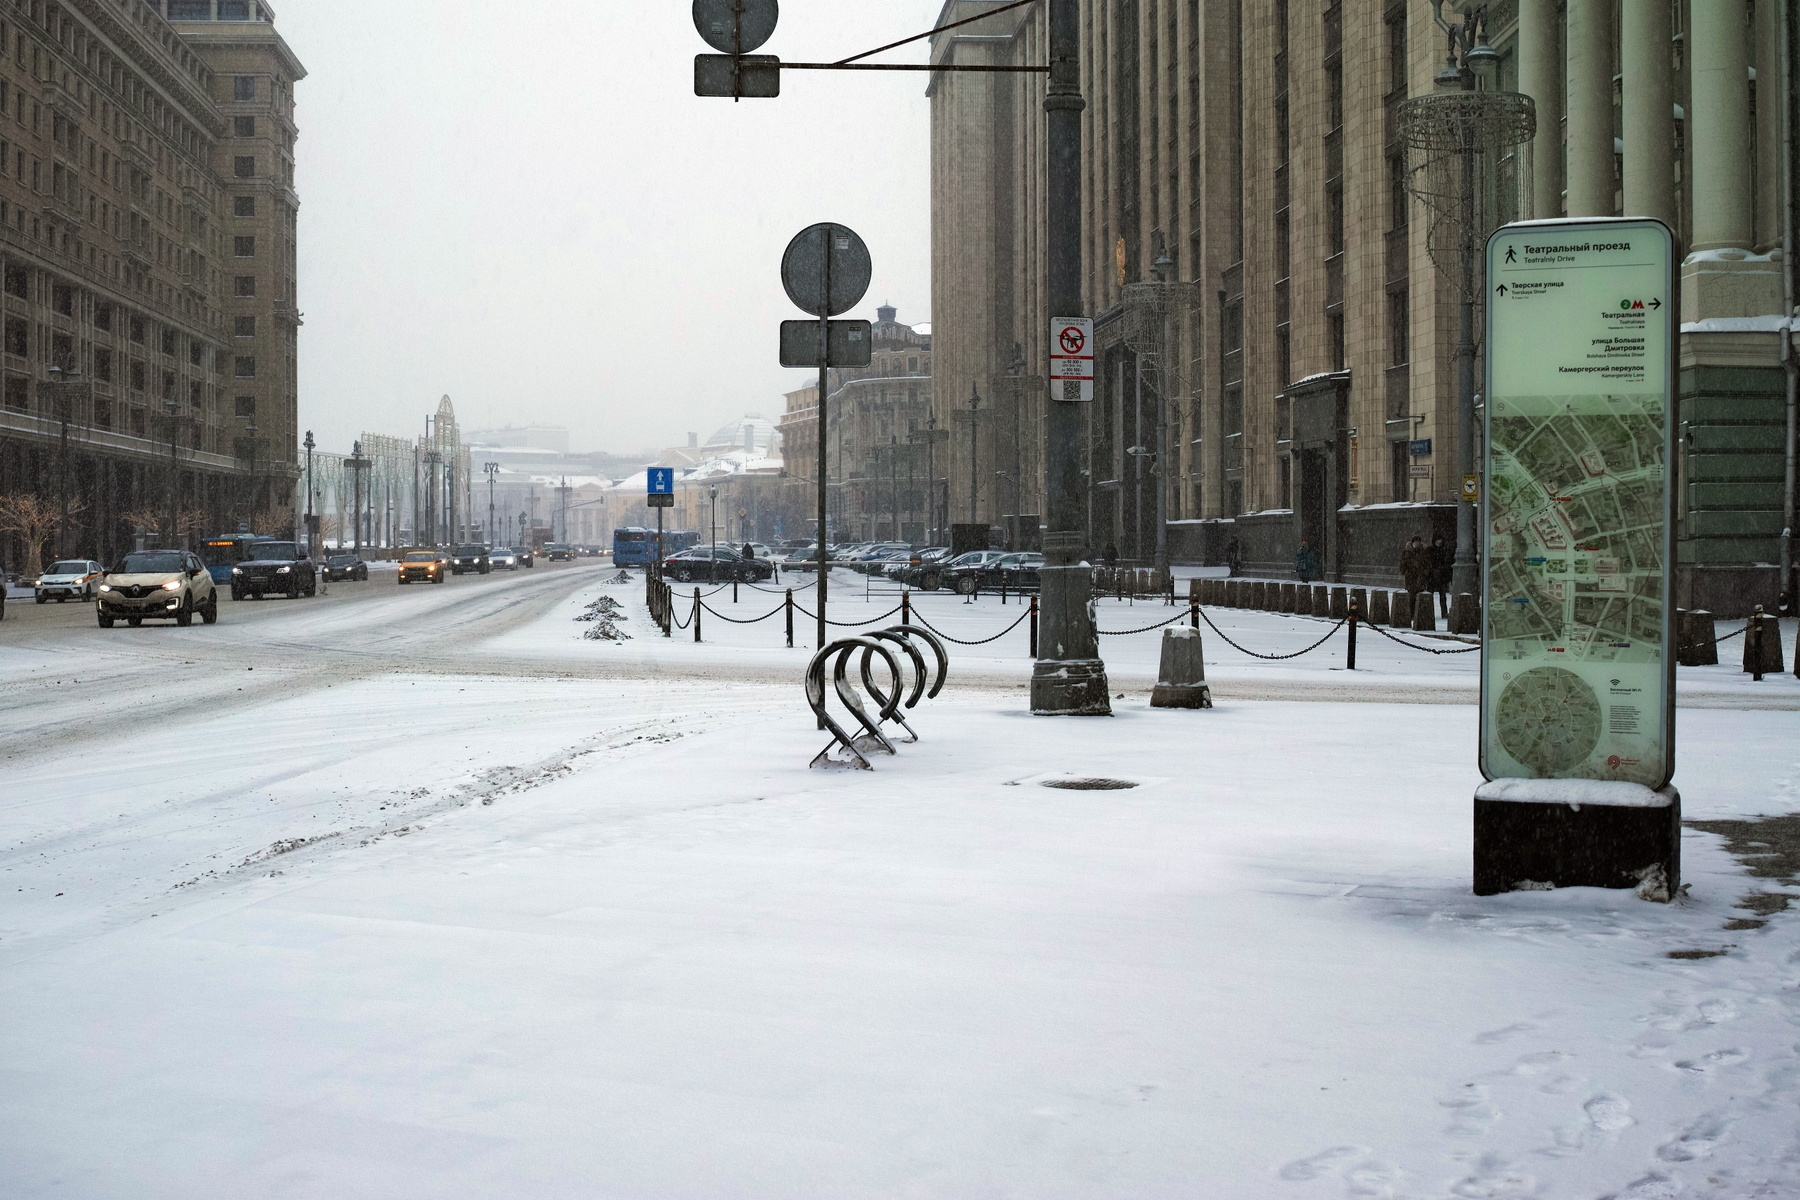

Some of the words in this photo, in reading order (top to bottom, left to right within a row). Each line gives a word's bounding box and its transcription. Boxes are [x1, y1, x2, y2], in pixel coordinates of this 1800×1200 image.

[1524, 243, 1590, 255] Театральный
[1593, 242, 1630, 252] проезд
[1524, 256, 1556, 264] Teatralniy
[1558, 365, 1610, 373] Камергерский
[1611, 365, 1645, 373] переулок
